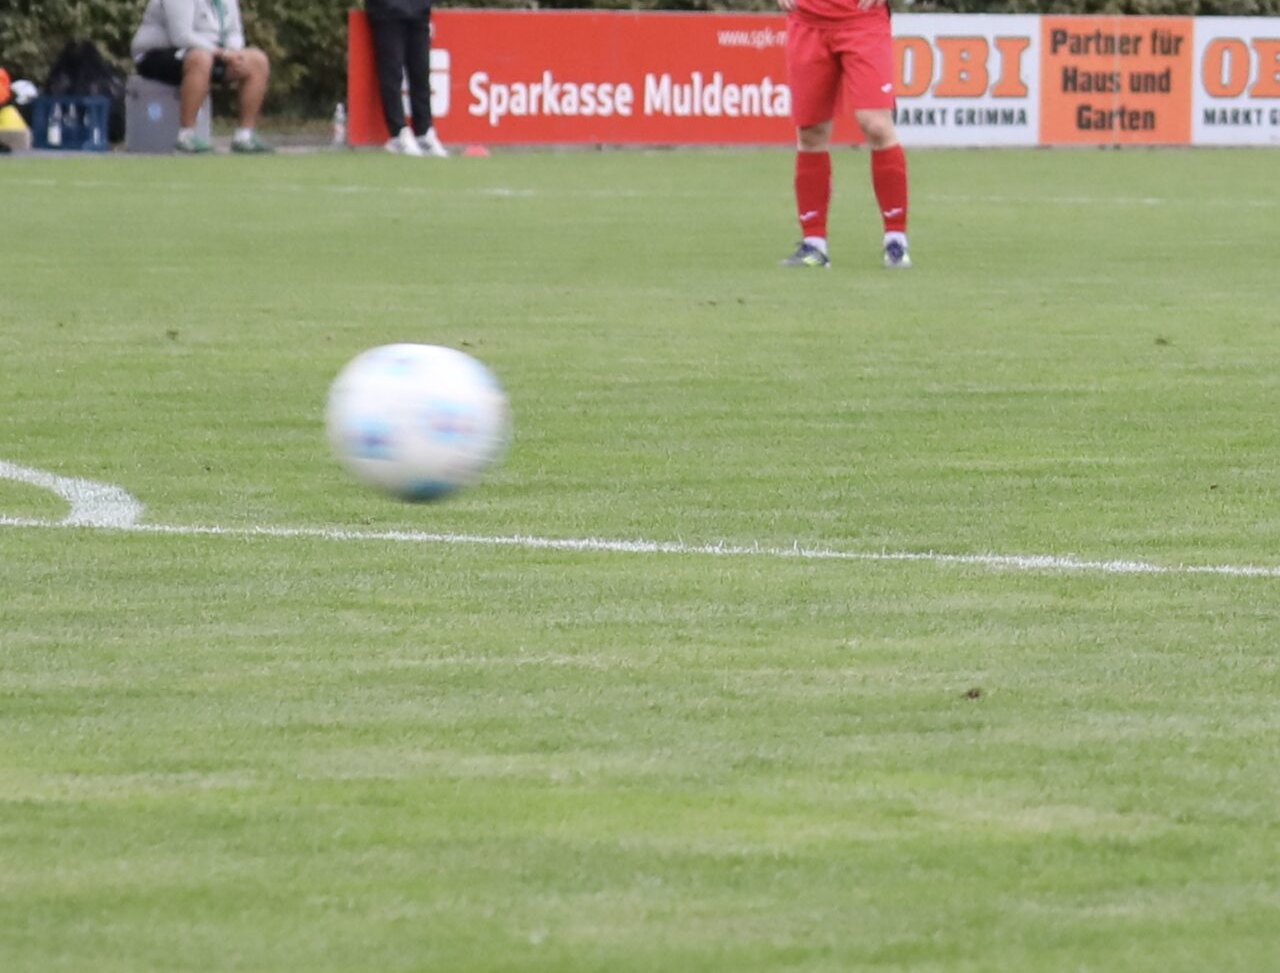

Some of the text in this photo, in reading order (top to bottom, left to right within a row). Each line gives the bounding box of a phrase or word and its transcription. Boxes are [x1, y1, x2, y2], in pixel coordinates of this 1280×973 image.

[1051, 29, 1184, 56] Partner für
[892, 36, 1030, 98] OBI
[1062, 66, 1171, 94] Haus und
[468, 70, 792, 126] Sparkasse Muldenta
[954, 108, 1027, 126] GRIMMA
[1076, 104, 1156, 131] Garten
[1203, 108, 1262, 126] MARKT
